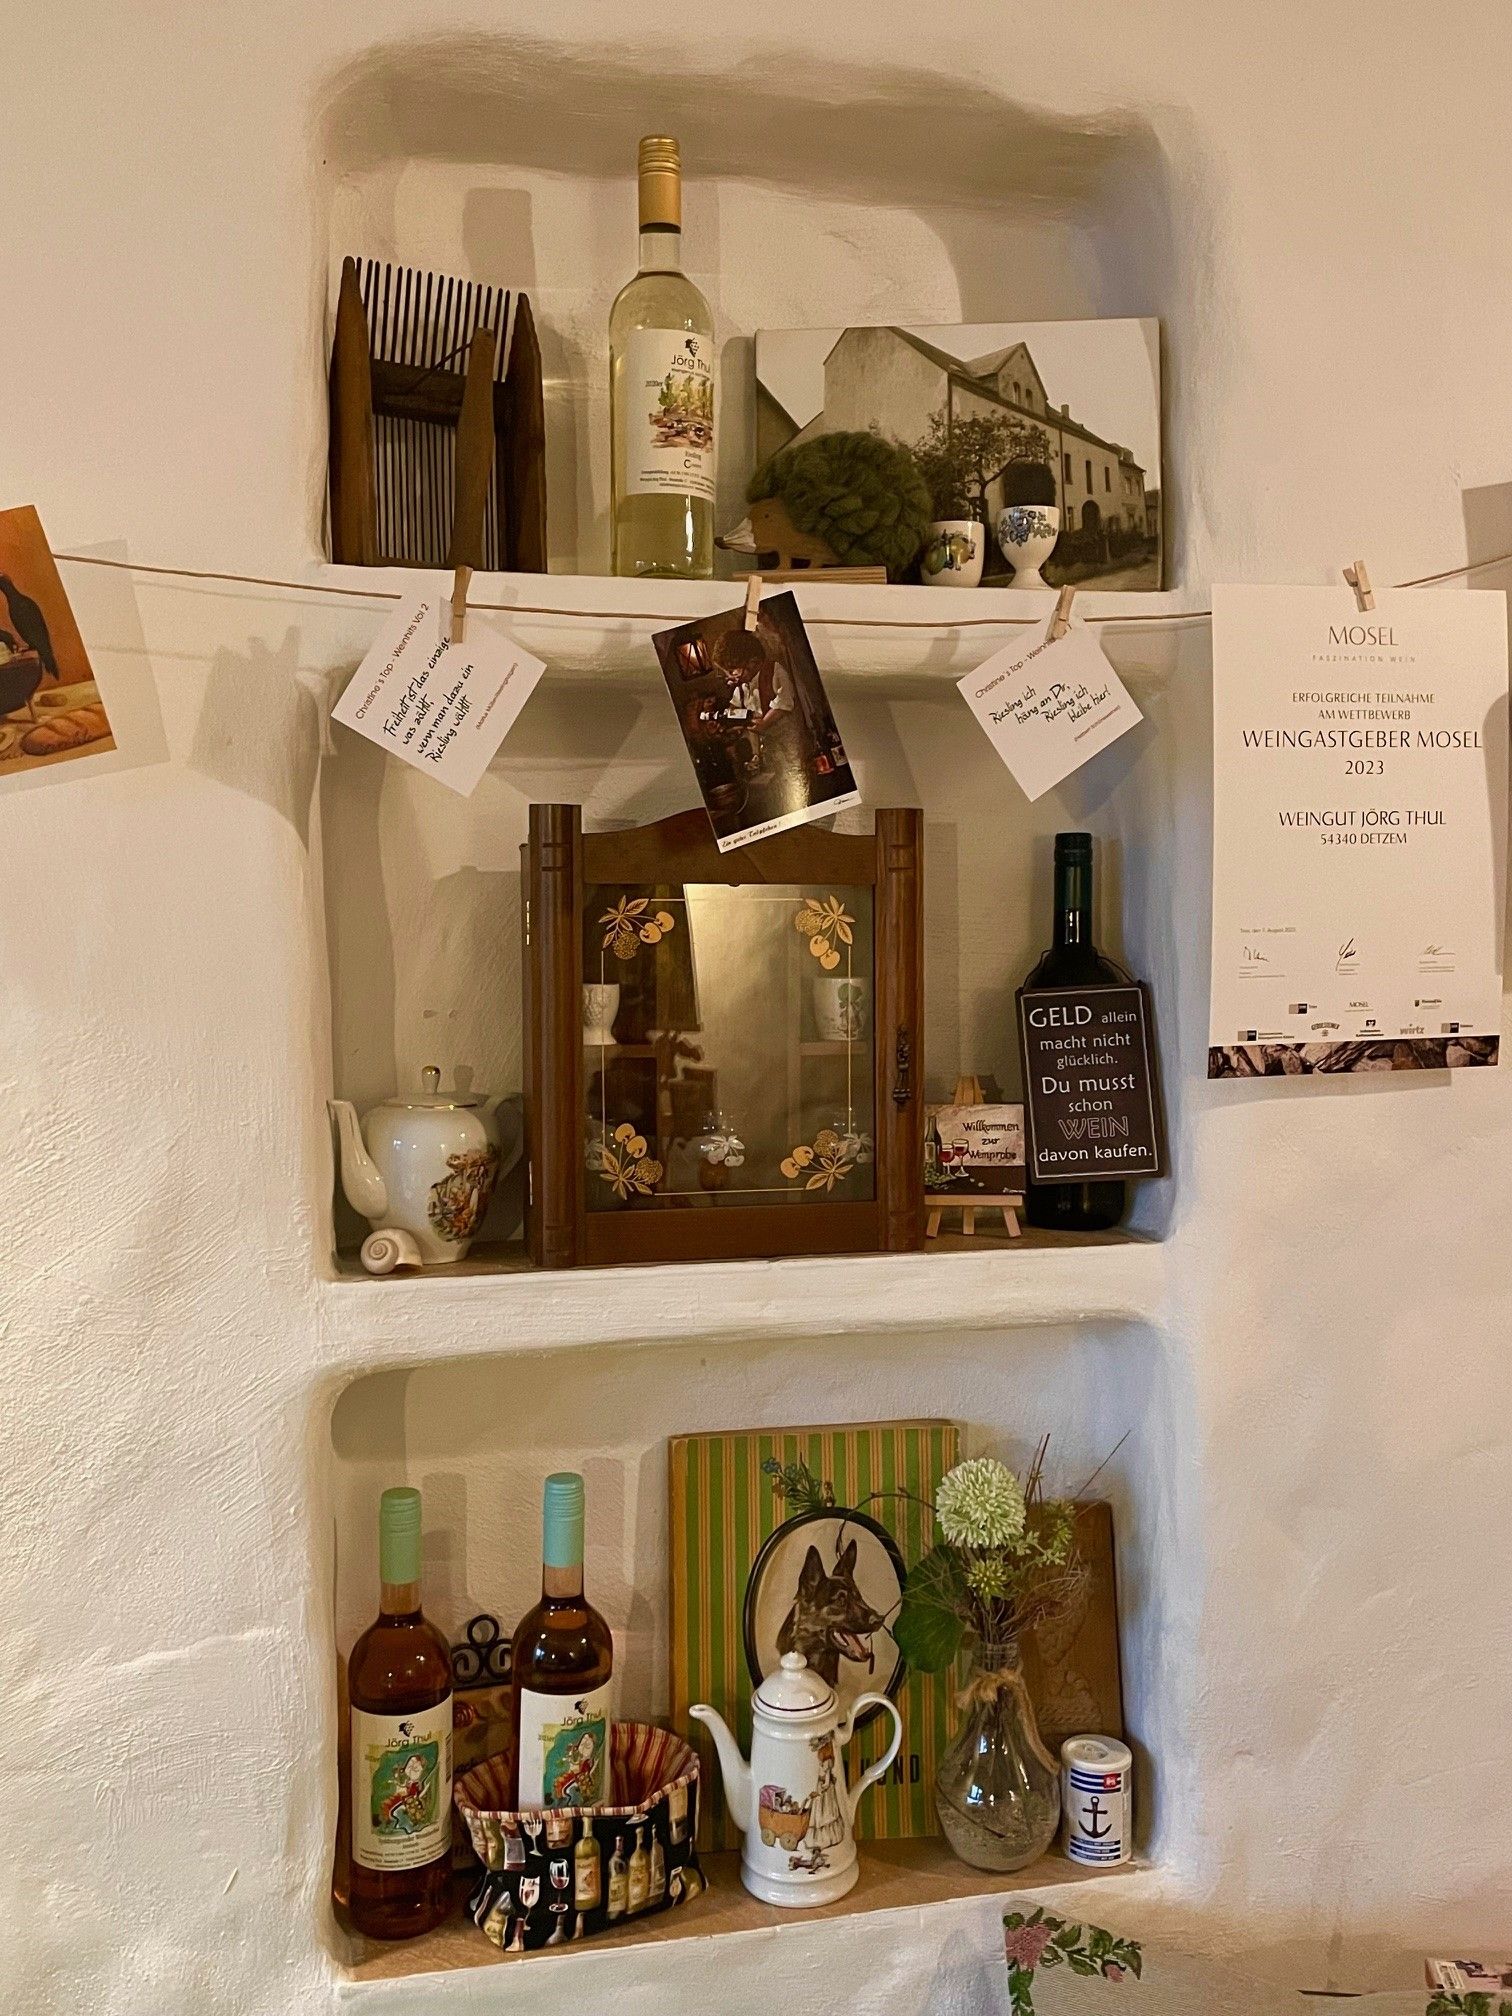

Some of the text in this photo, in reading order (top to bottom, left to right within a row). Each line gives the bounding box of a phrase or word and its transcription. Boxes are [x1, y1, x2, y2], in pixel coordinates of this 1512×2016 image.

[671, 354, 695, 370] Jörg
[379, 664, 394, 678] Top
[392, 625, 418, 658] Weinhits
[412, 609, 425, 624] Vol
[420, 602, 430, 611] 2
[1328, 626, 1399, 646] MOSEL
[1009, 660, 1024, 673] Top
[383, 689, 410, 738] Freiheit
[412, 671, 430, 690] das
[428, 637, 451, 669] einzige
[988, 685, 1037, 725] Riesling ich
[1041, 684, 1089, 723] Riesling ich
[1068, 703, 1092, 724] bleibe
[1091, 684, 1112, 706] hier!
[1292, 692, 1435, 704] ERFOLGREICHE TEILNAHME
[417, 664, 474, 753] wenn man dazu ein
[1014, 706, 1039, 725] häng
[1040, 696, 1052, 708] an
[1318, 709, 1411, 720] AM WETTBEWERB
[403, 727, 416, 745] was
[425, 728, 457, 763] Riesling
[1242, 730, 1483, 749] WEINGASTGEBER MOSEL
[1345, 760, 1384, 775] 2023
[1279, 808, 1446, 828] WEINGUT JÖRG THUL
[1320, 833, 1408, 845] 54340 DETZEM
[1029, 1005, 1137, 1028] GELD allein
[1400, 1024, 1425, 1035] wirtz
[1040, 1032, 1131, 1051] macht nicht
[1056, 1052, 1118, 1070] glücklich.
[1041, 1074, 1136, 1094] Du musst
[1068, 1098, 1113, 1113] schon
[962, 1120, 1020, 1135] Willkommen
[1057, 1115, 1130, 1140] WEIN
[981, 1137, 1000, 1146] zur
[1038, 1143, 1153, 1162] davon kaufen.
[561, 1716, 584, 1727] Jörg
[384, 1730, 432, 1750] Jörg Thul
